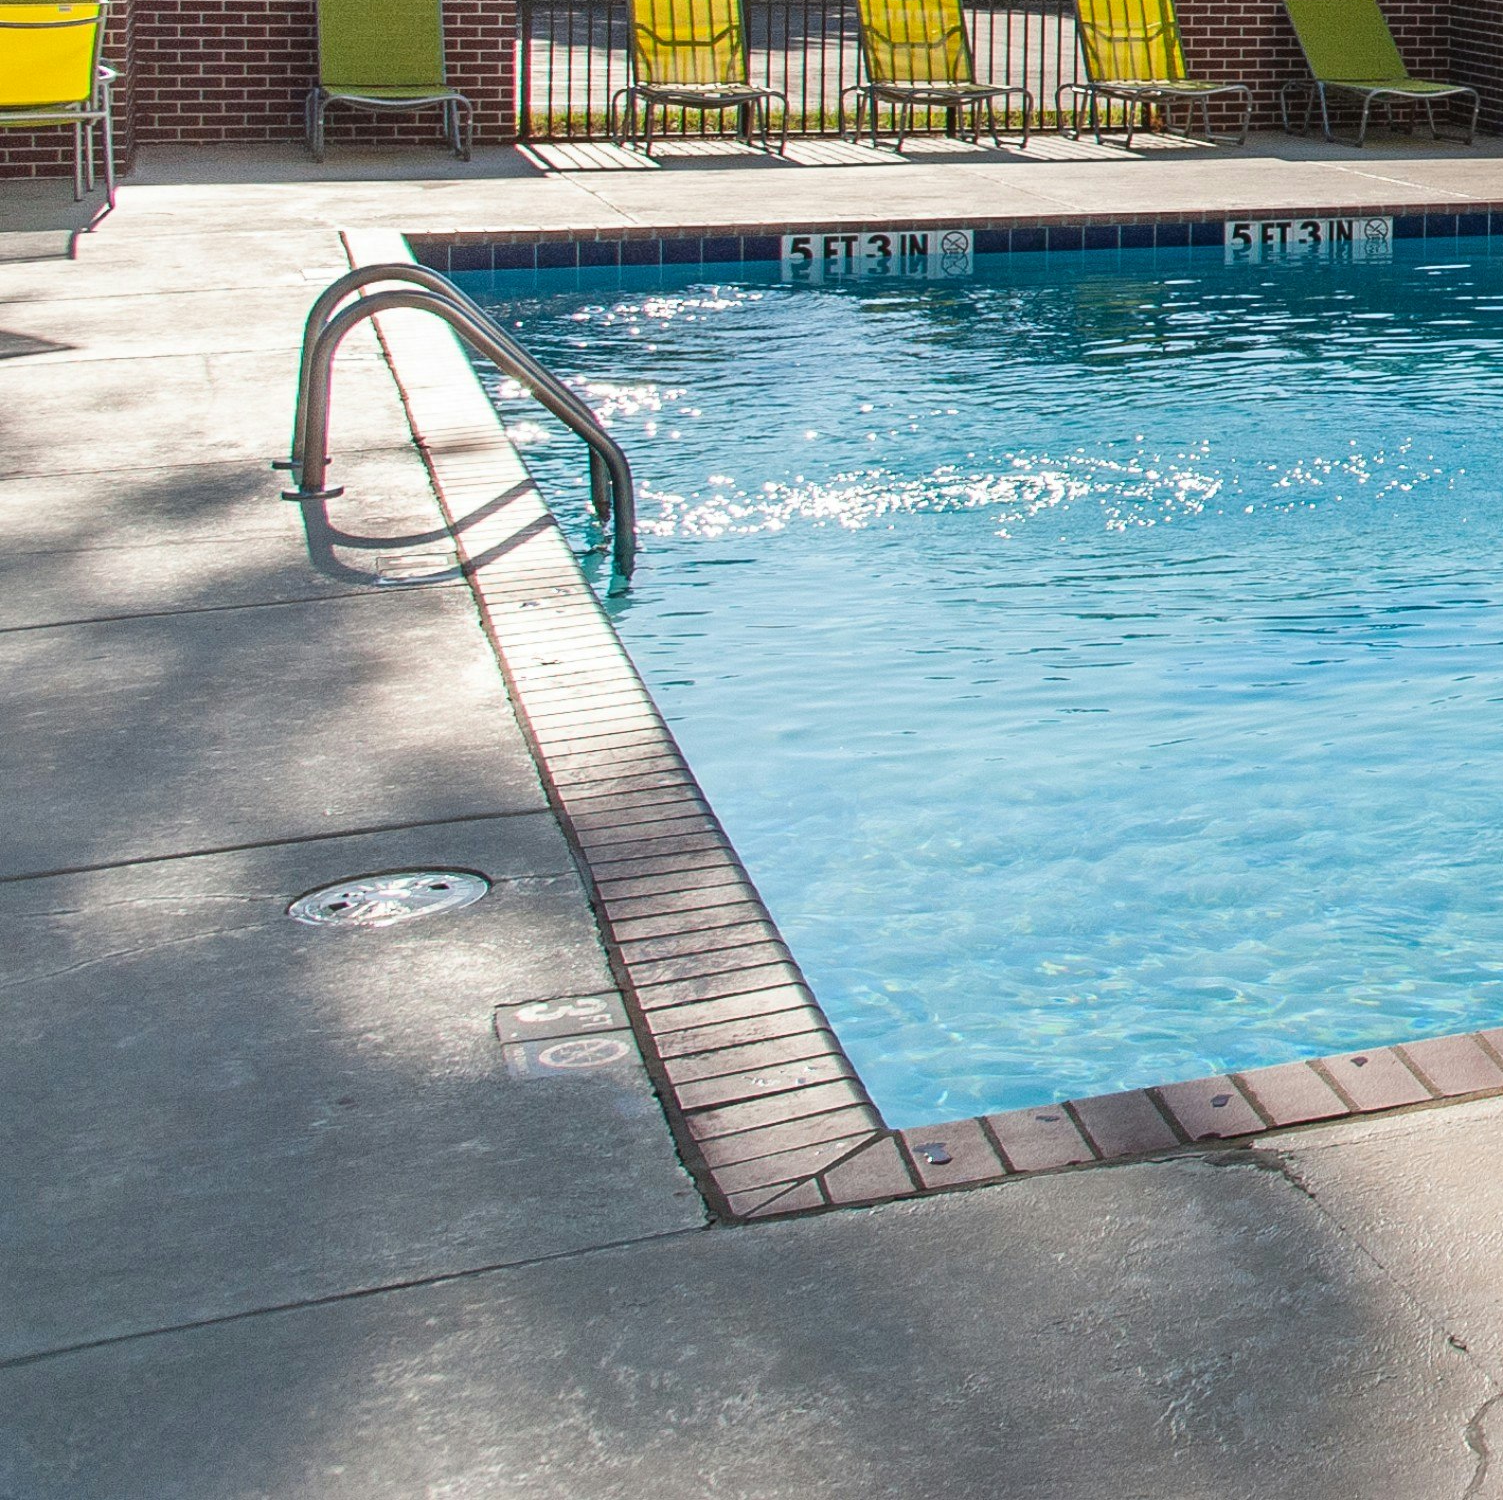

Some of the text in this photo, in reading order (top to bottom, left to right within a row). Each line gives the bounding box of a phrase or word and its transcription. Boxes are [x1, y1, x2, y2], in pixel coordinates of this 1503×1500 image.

[1232, 219, 1353, 246] 5 FT 3 IN
[791, 233, 929, 260] 5 FT 3 IN
